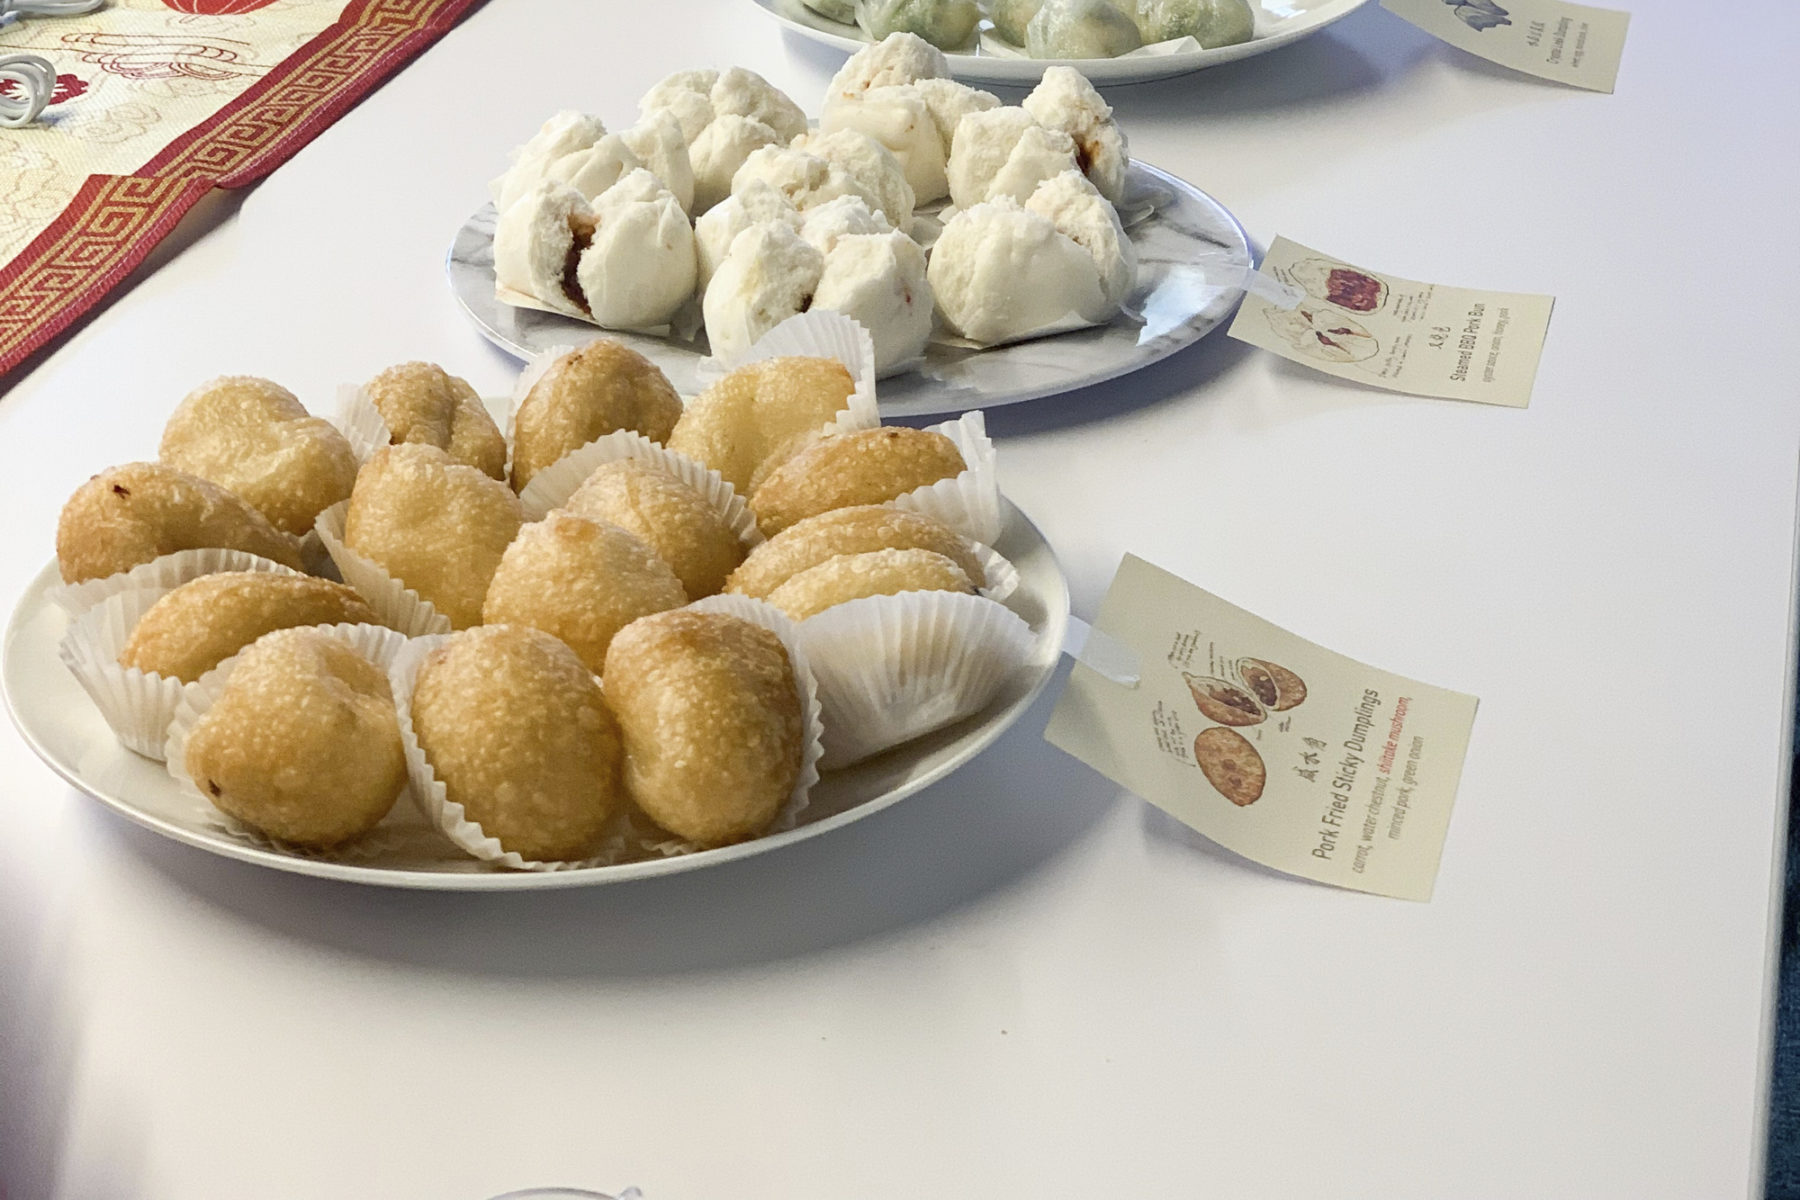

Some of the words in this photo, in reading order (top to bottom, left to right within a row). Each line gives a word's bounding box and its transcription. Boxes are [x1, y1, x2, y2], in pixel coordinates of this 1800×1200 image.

[1468, 303, 1485, 317] Bun
[1458, 334, 1477, 349] BBQ
[1463, 319, 1481, 334] Pork
[1449, 350, 1472, 381] Steamed
[1344, 688, 1382, 752] Dumplings
[1389, 696, 1413, 742] mushroom,
[1377, 741, 1398, 775] shiitake
[1409, 735, 1424, 760] onion
[1332, 752, 1365, 792] Sticky
[1402, 759, 1418, 786] green
[1322, 792, 1349, 828] Fried
[1365, 776, 1391, 816] chestnut,
[1396, 786, 1414, 809] pork,
[1361, 816, 1377, 842] water
[1387, 805, 1406, 840] minced
[1312, 830, 1339, 860] Pork
[1352, 844, 1373, 874] carrot,
